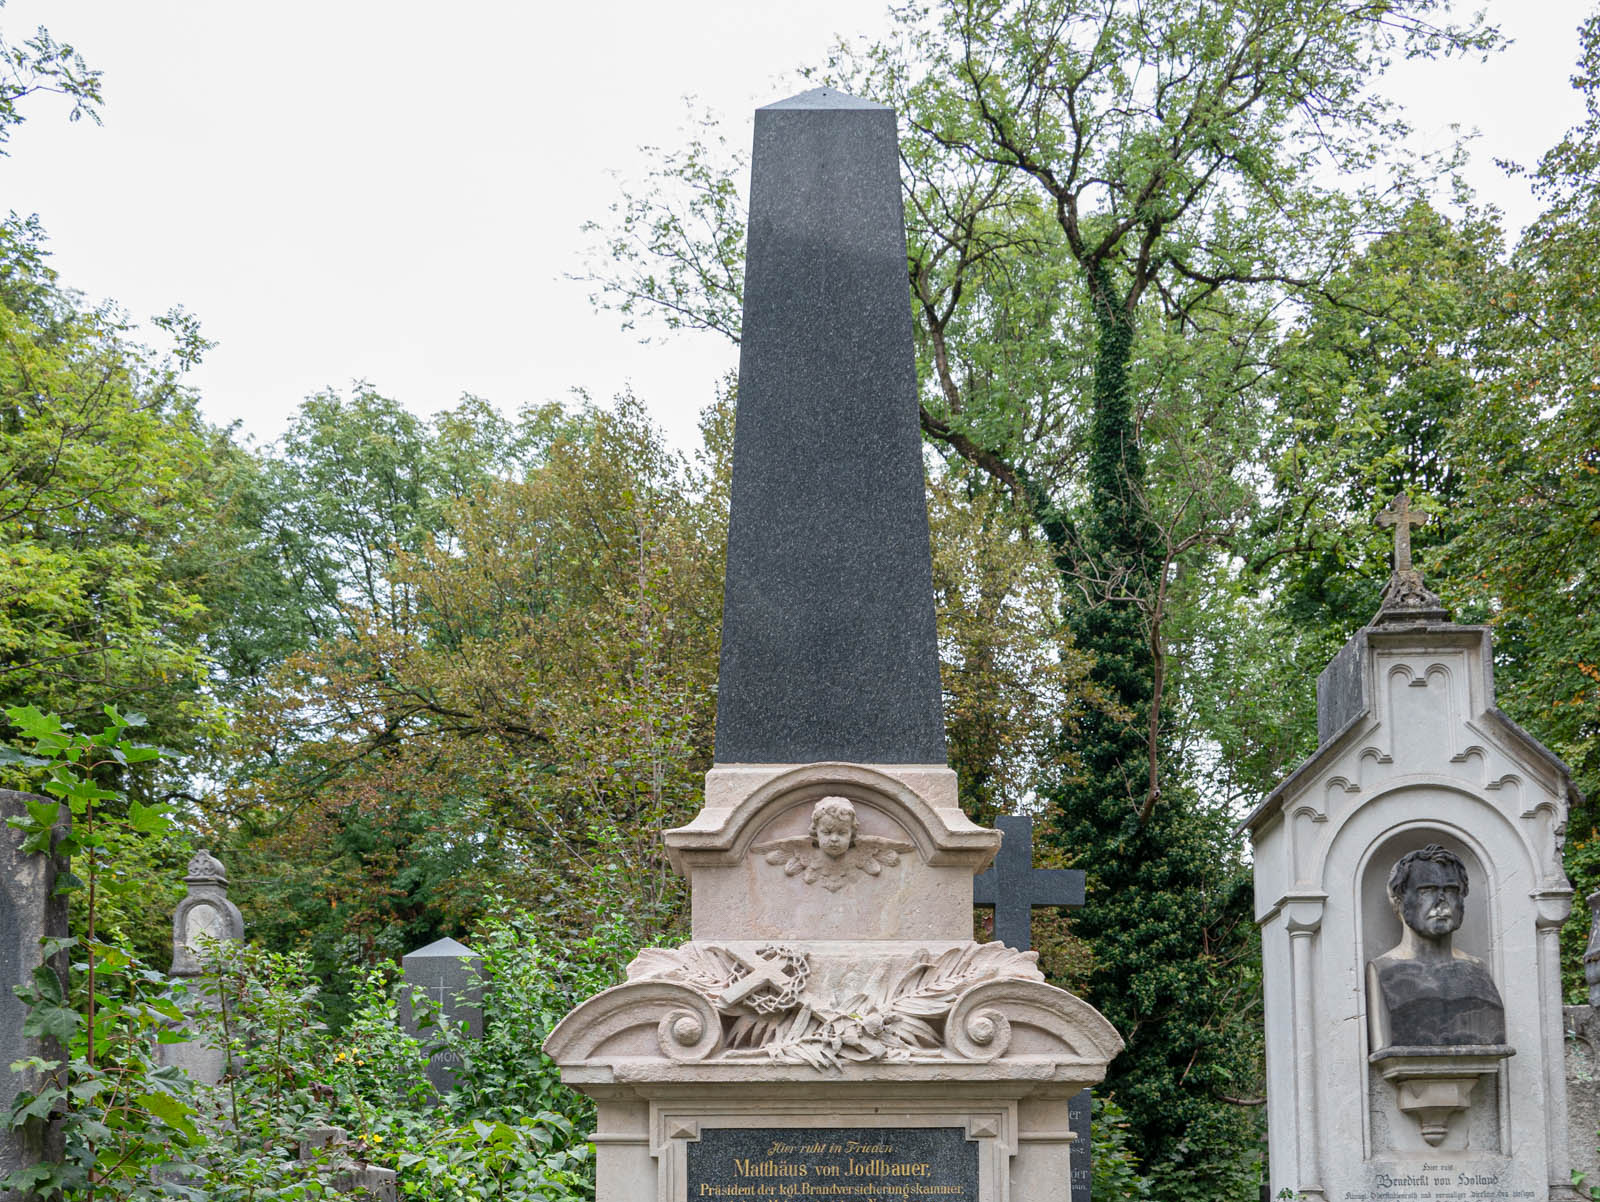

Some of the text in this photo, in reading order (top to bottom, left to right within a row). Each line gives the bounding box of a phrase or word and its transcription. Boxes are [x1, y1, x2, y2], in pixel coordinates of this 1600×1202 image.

[767, 1140, 894, 1156] Hier ruht in Frieden
[733, 1157, 932, 1177] Matthäus von Jodlbauer,
[1434, 1177, 1451, 1186] von
[1458, 1173, 1499, 1186] Holland
[700, 1183, 755, 1196] Präsident
[757, 1183, 777, 1195] der
